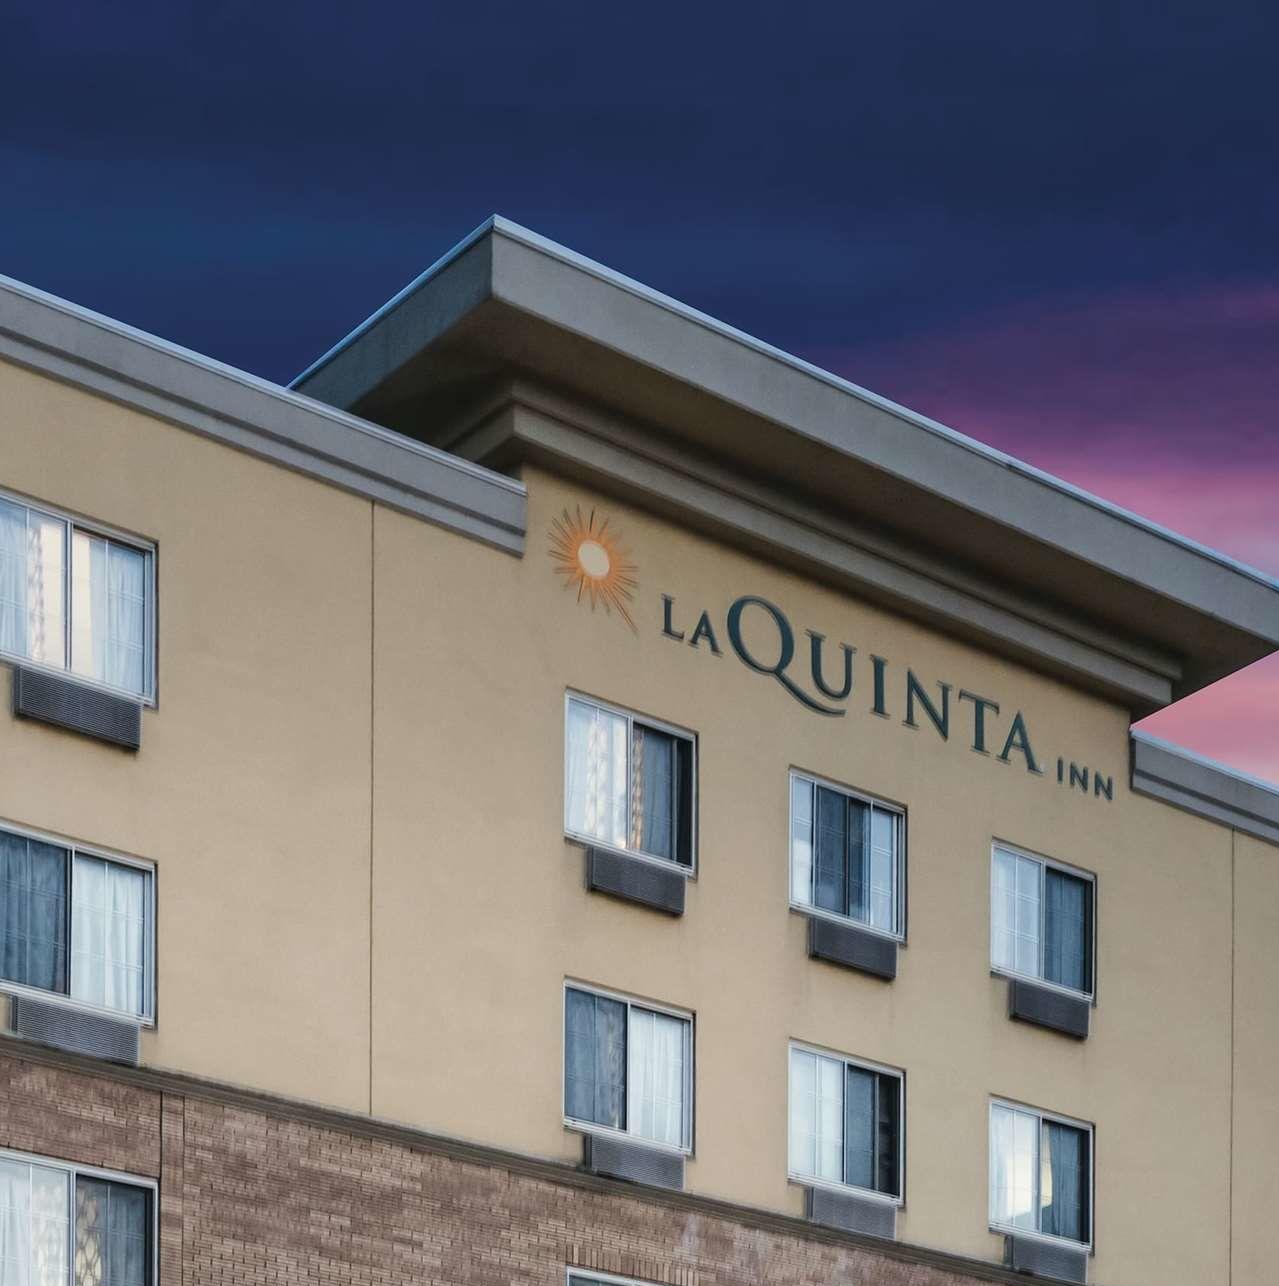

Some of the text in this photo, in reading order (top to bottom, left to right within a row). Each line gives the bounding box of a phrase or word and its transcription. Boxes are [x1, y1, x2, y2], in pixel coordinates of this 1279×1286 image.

[660, 593, 1114, 801] LA QUINTA INN
